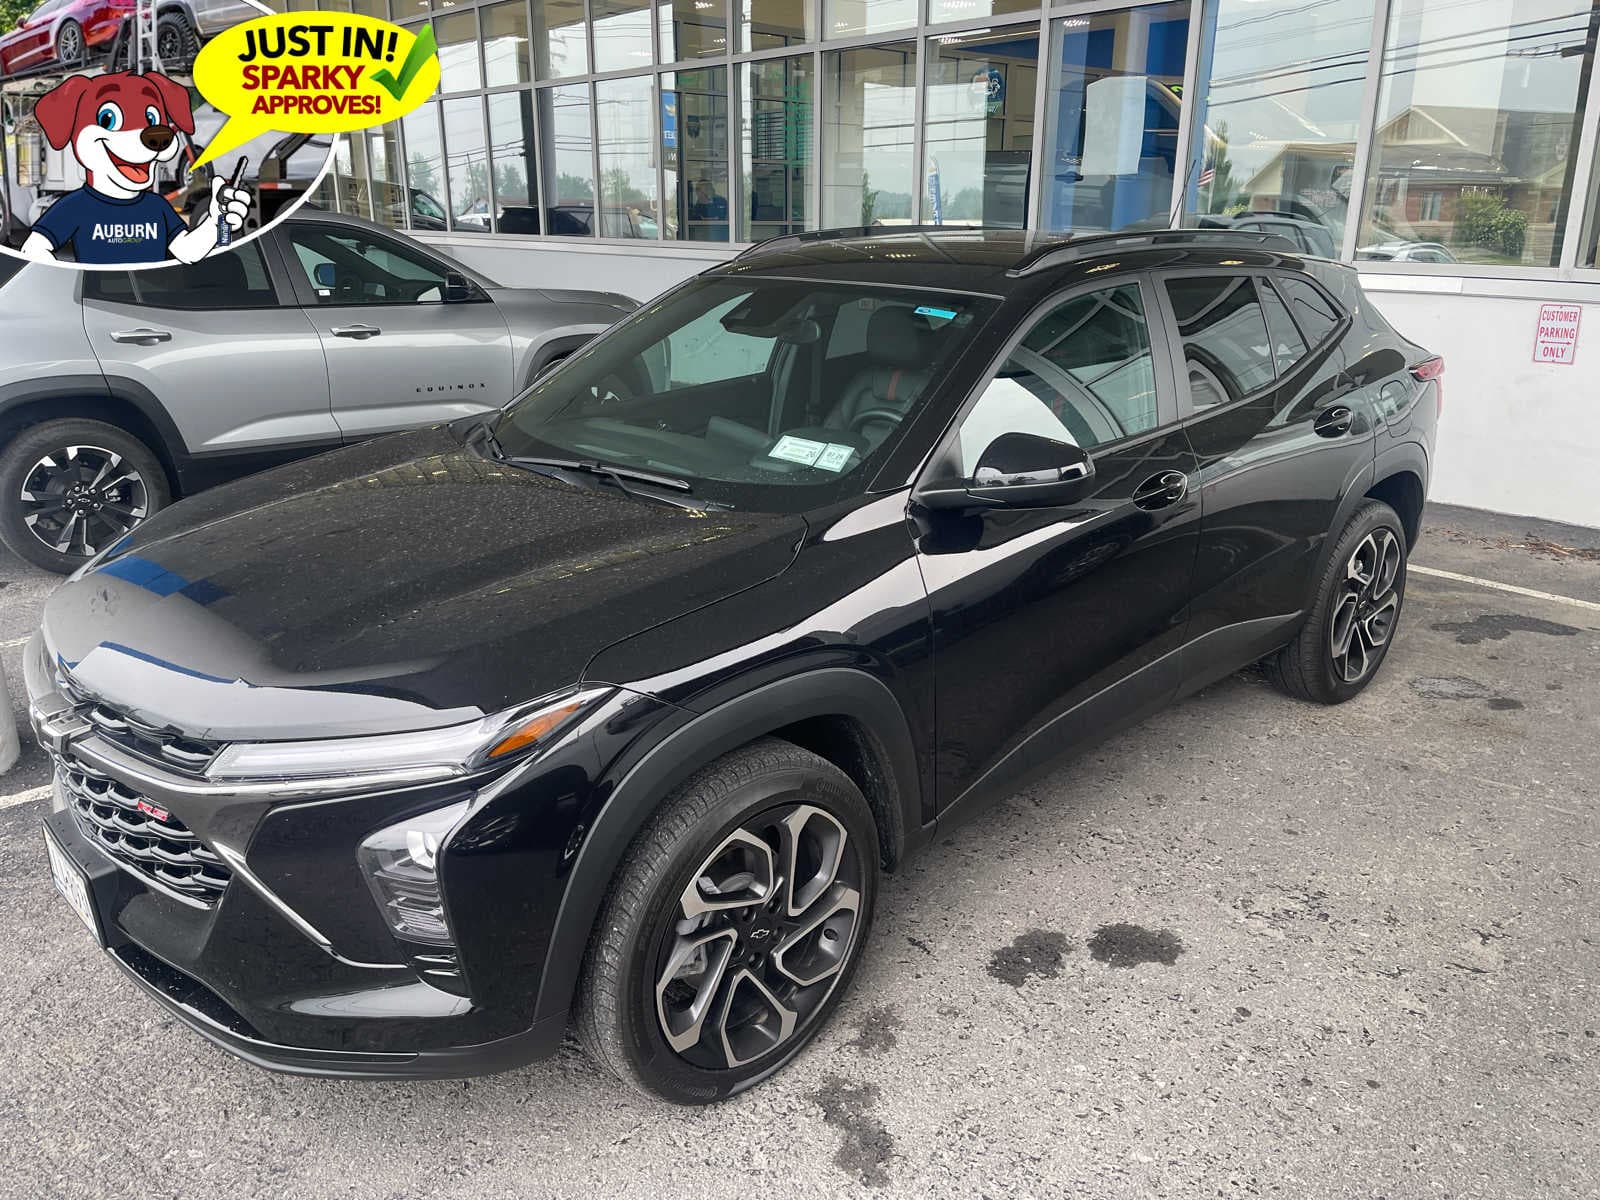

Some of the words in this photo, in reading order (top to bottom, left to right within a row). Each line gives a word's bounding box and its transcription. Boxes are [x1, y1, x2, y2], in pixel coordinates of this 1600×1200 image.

[1542, 310, 1578, 322] CUSTOMER
[1539, 326, 1576, 339] PARKING
[1542, 346, 1566, 358] ONLY
[416, 383, 485, 393] EQUINOX
